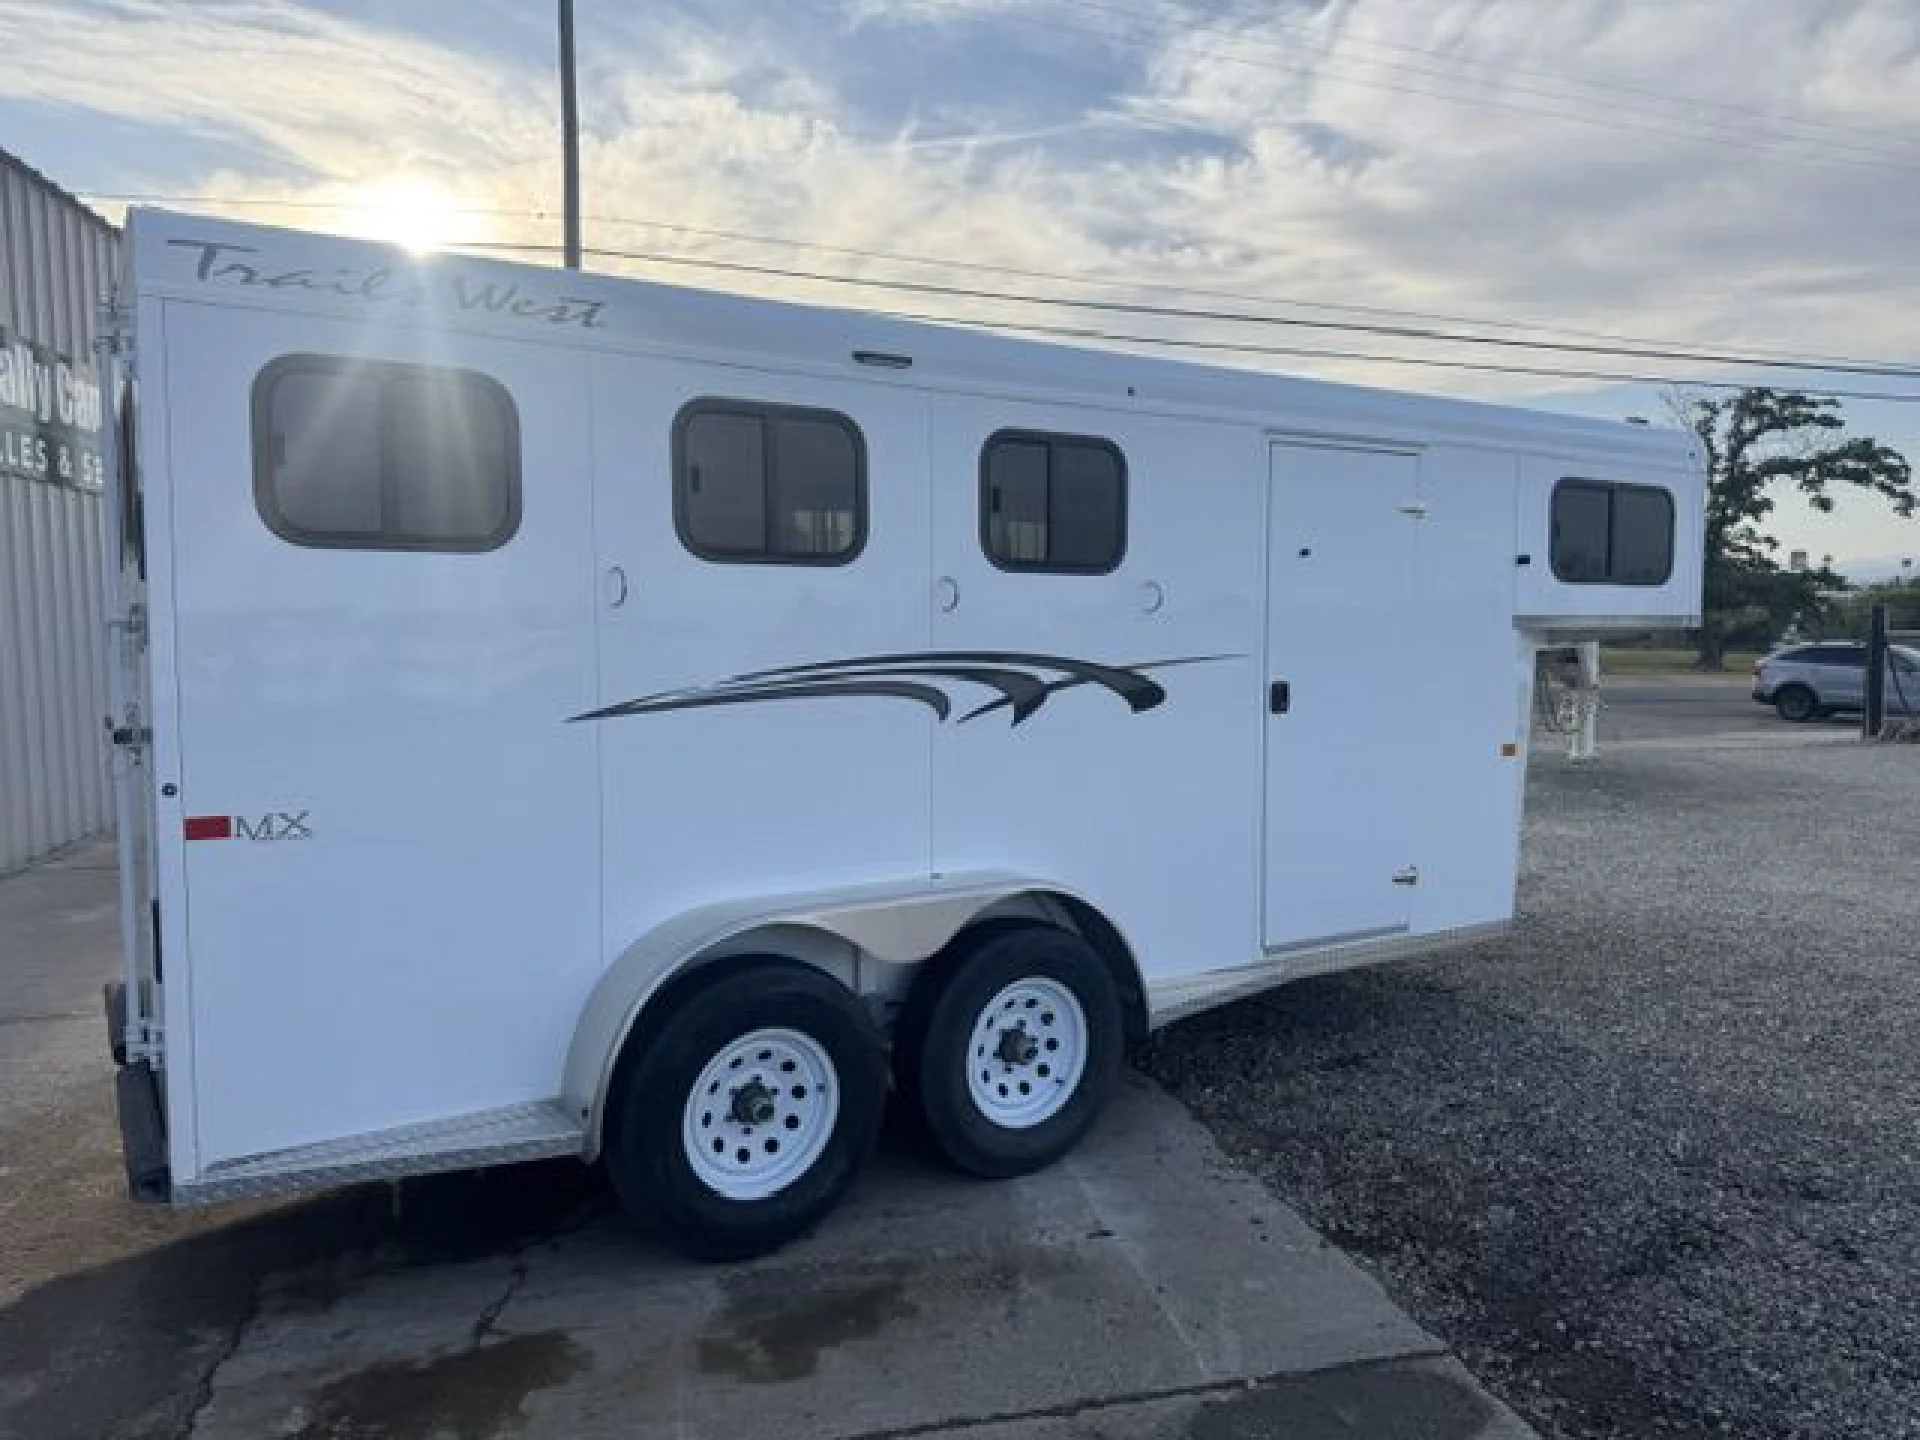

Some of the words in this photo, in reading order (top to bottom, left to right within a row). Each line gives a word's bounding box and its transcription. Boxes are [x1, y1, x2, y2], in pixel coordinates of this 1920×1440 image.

[452, 272, 606, 328] West
[0, 431, 48, 472] LES
[59, 445, 73, 478] &
[235, 810, 312, 840] MX
